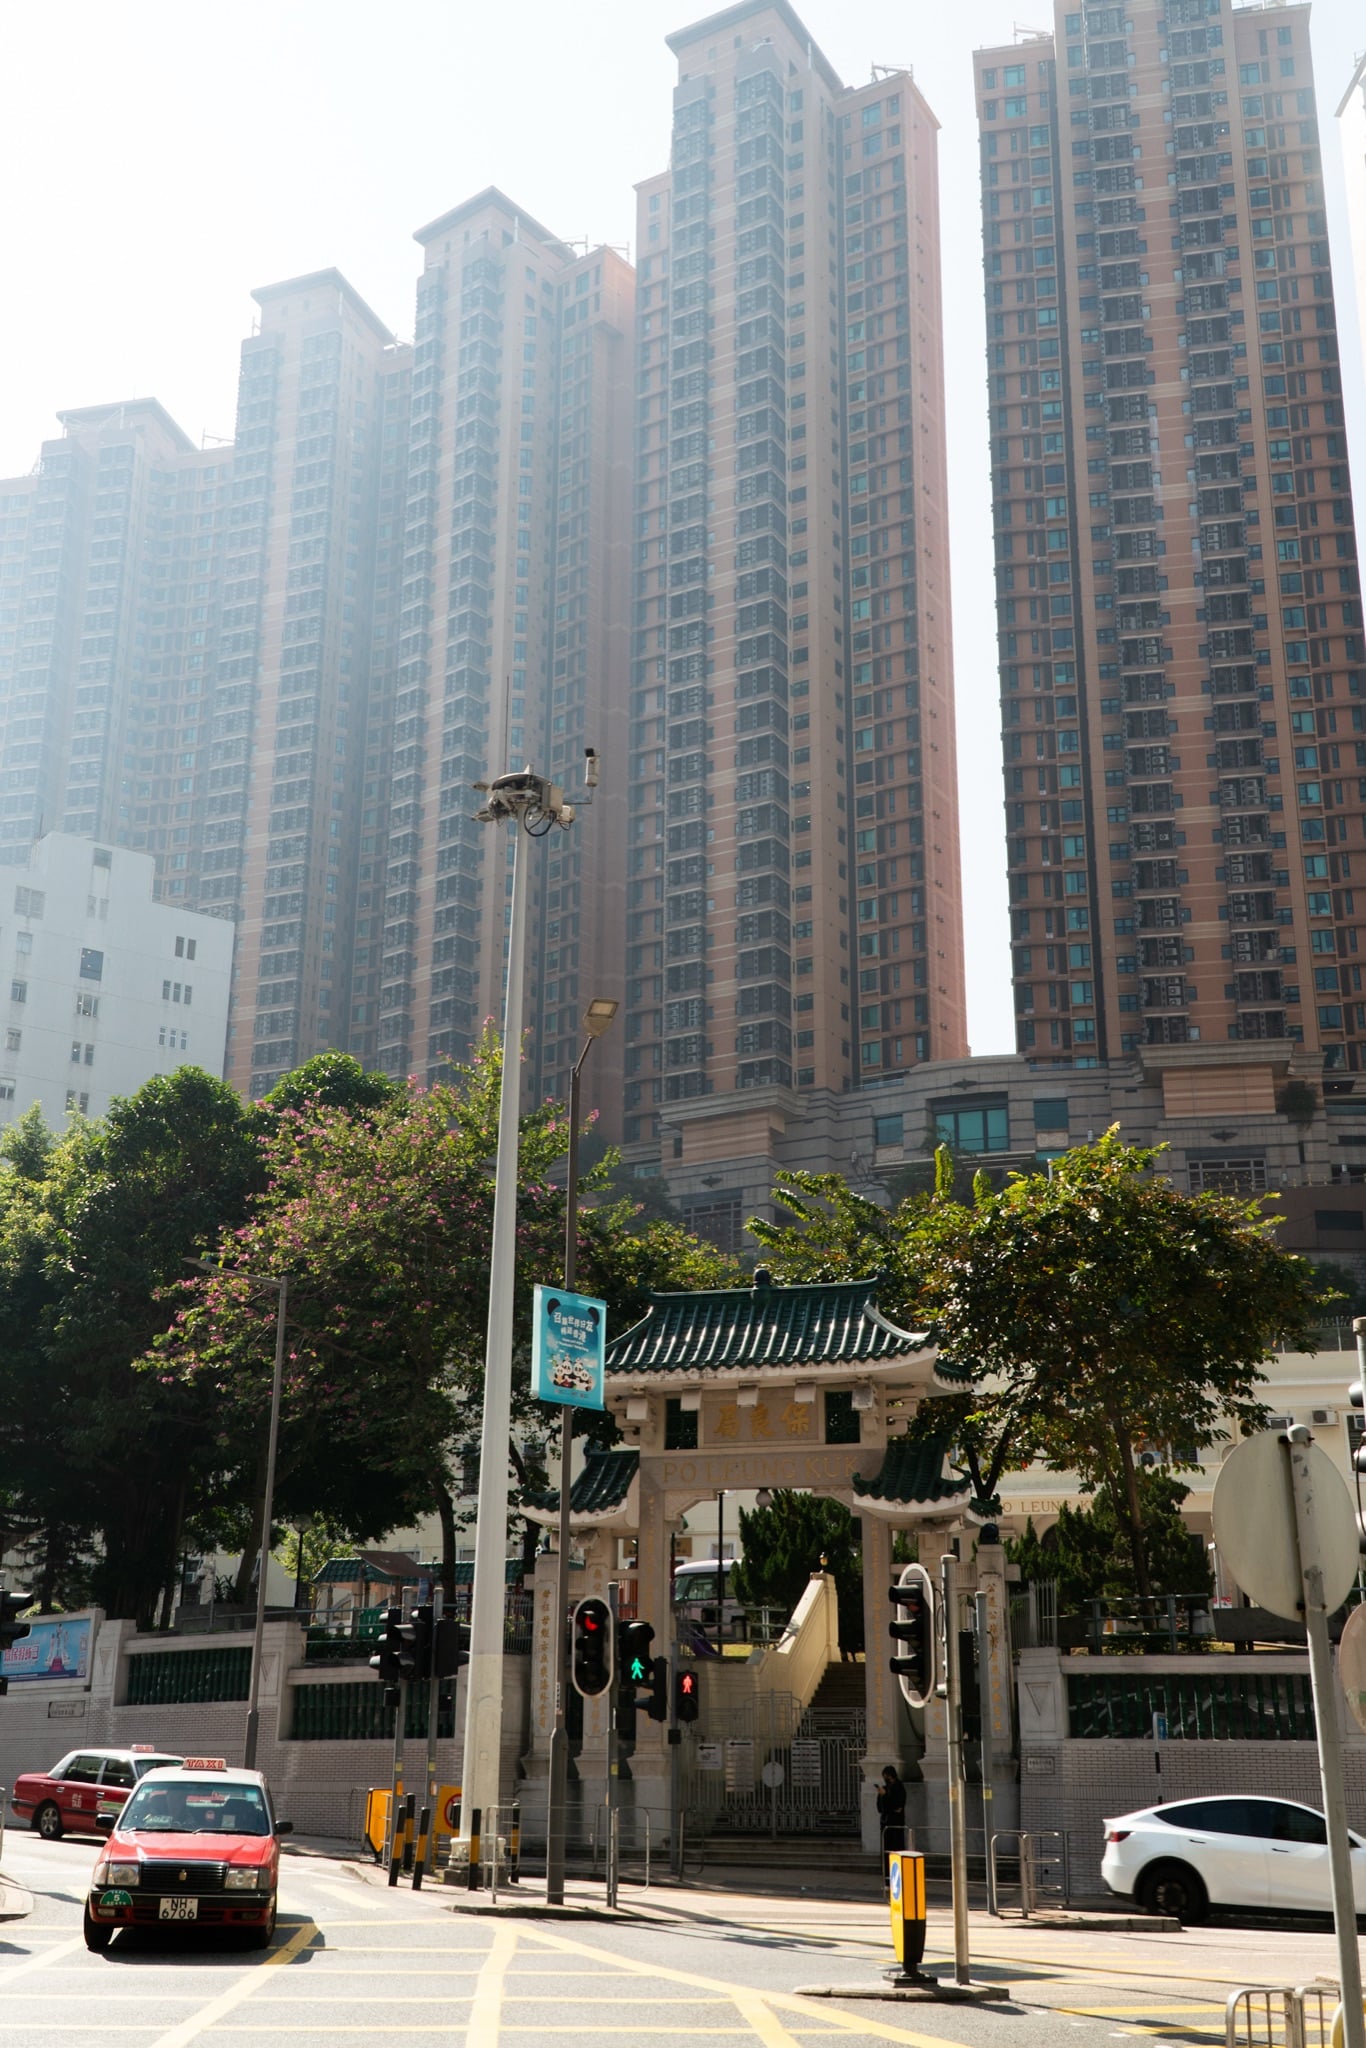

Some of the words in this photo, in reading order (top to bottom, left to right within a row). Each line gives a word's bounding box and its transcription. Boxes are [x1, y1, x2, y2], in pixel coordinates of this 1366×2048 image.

[714, 1402, 811, 1438] 保良局
[663, 1461, 697, 1484] PO
[705, 1458, 796, 1483] LEUNG
[805, 1455, 859, 1479] KUK
[186, 1759, 224, 1769] TAXI
[113, 1894, 121, 1902] 5
[171, 1898, 188, 1909] NH
[161, 1908, 195, 1919] 6706
